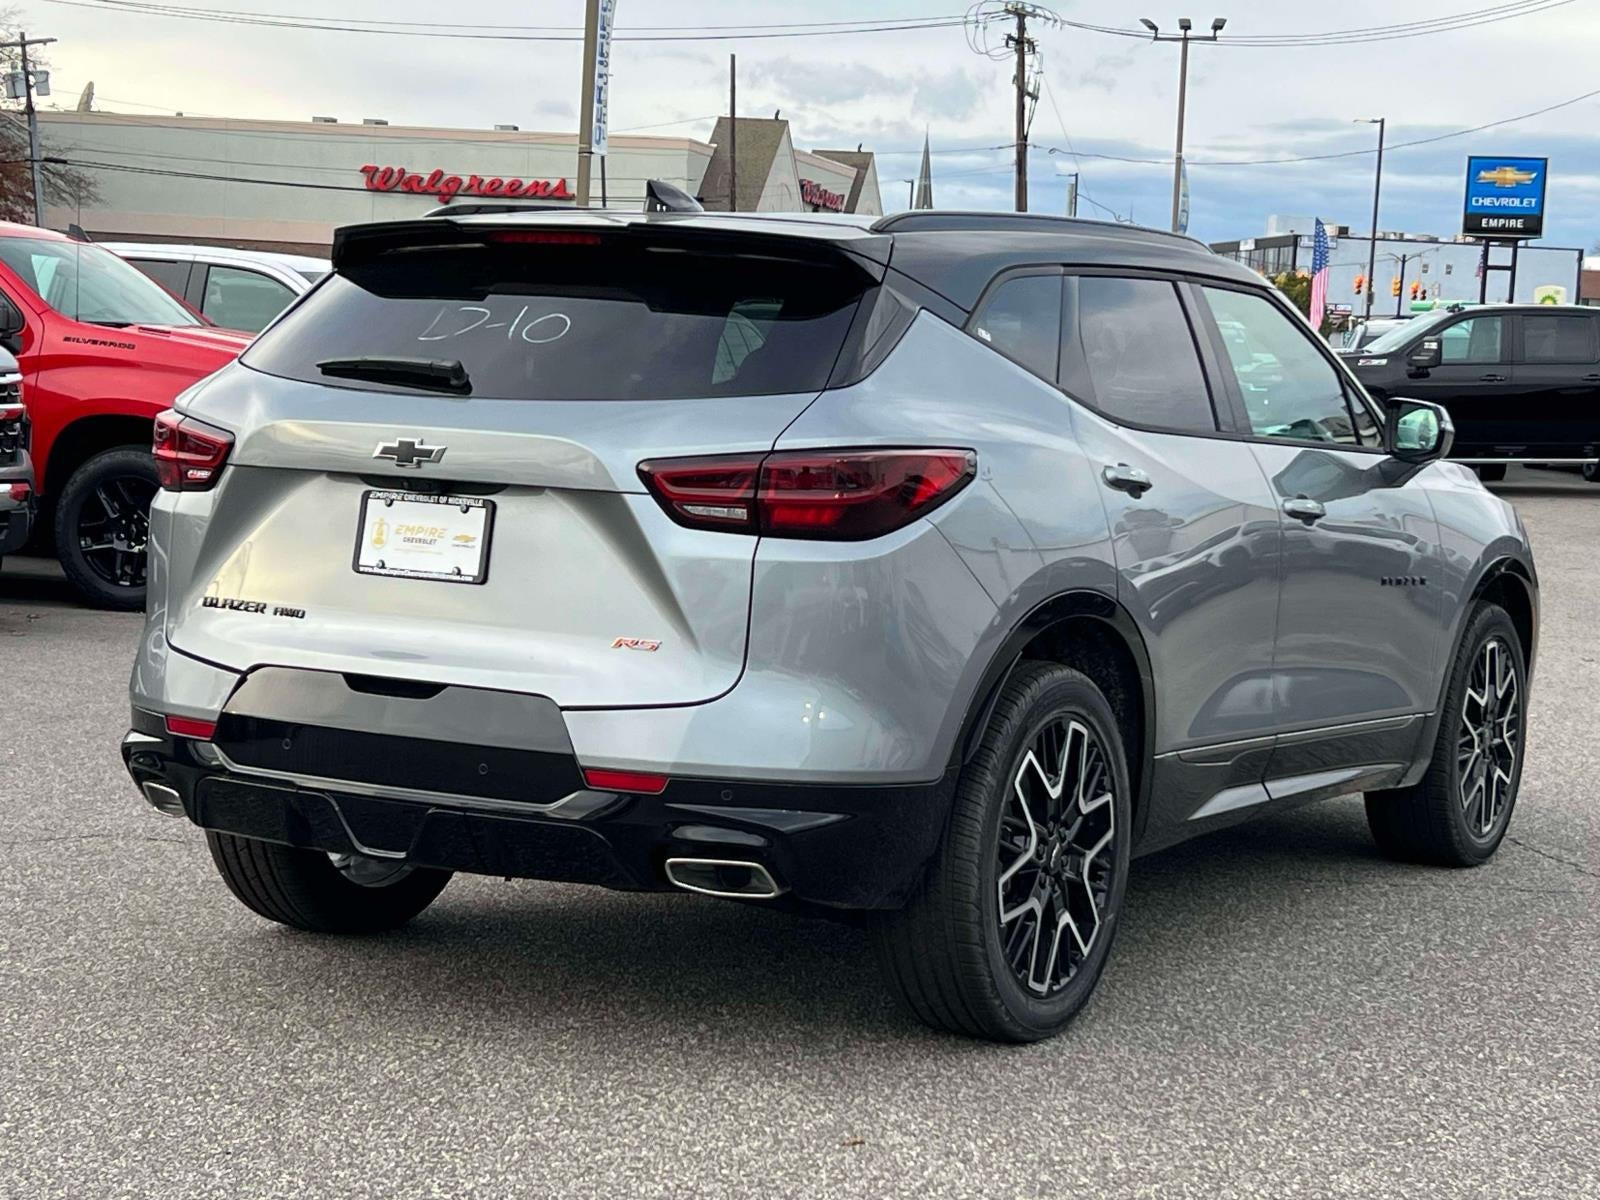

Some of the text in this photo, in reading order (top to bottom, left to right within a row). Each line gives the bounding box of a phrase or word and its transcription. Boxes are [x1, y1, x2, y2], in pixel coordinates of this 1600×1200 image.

[359, 164, 576, 205] Walgreens
[1471, 197, 1537, 207] CHEVROLET
[1481, 218, 1524, 228] EMPIRE
[63, 336, 136, 349] SILVERADO
[370, 491, 402, 500] EMPIRE
[403, 493, 438, 504] CHEVROLET
[394, 525, 447, 539] EMPIRE
[402, 537, 437, 545] CHEVROLET
[202, 597, 306, 619] BLAZER AWD
[610, 637, 662, 651] RS
